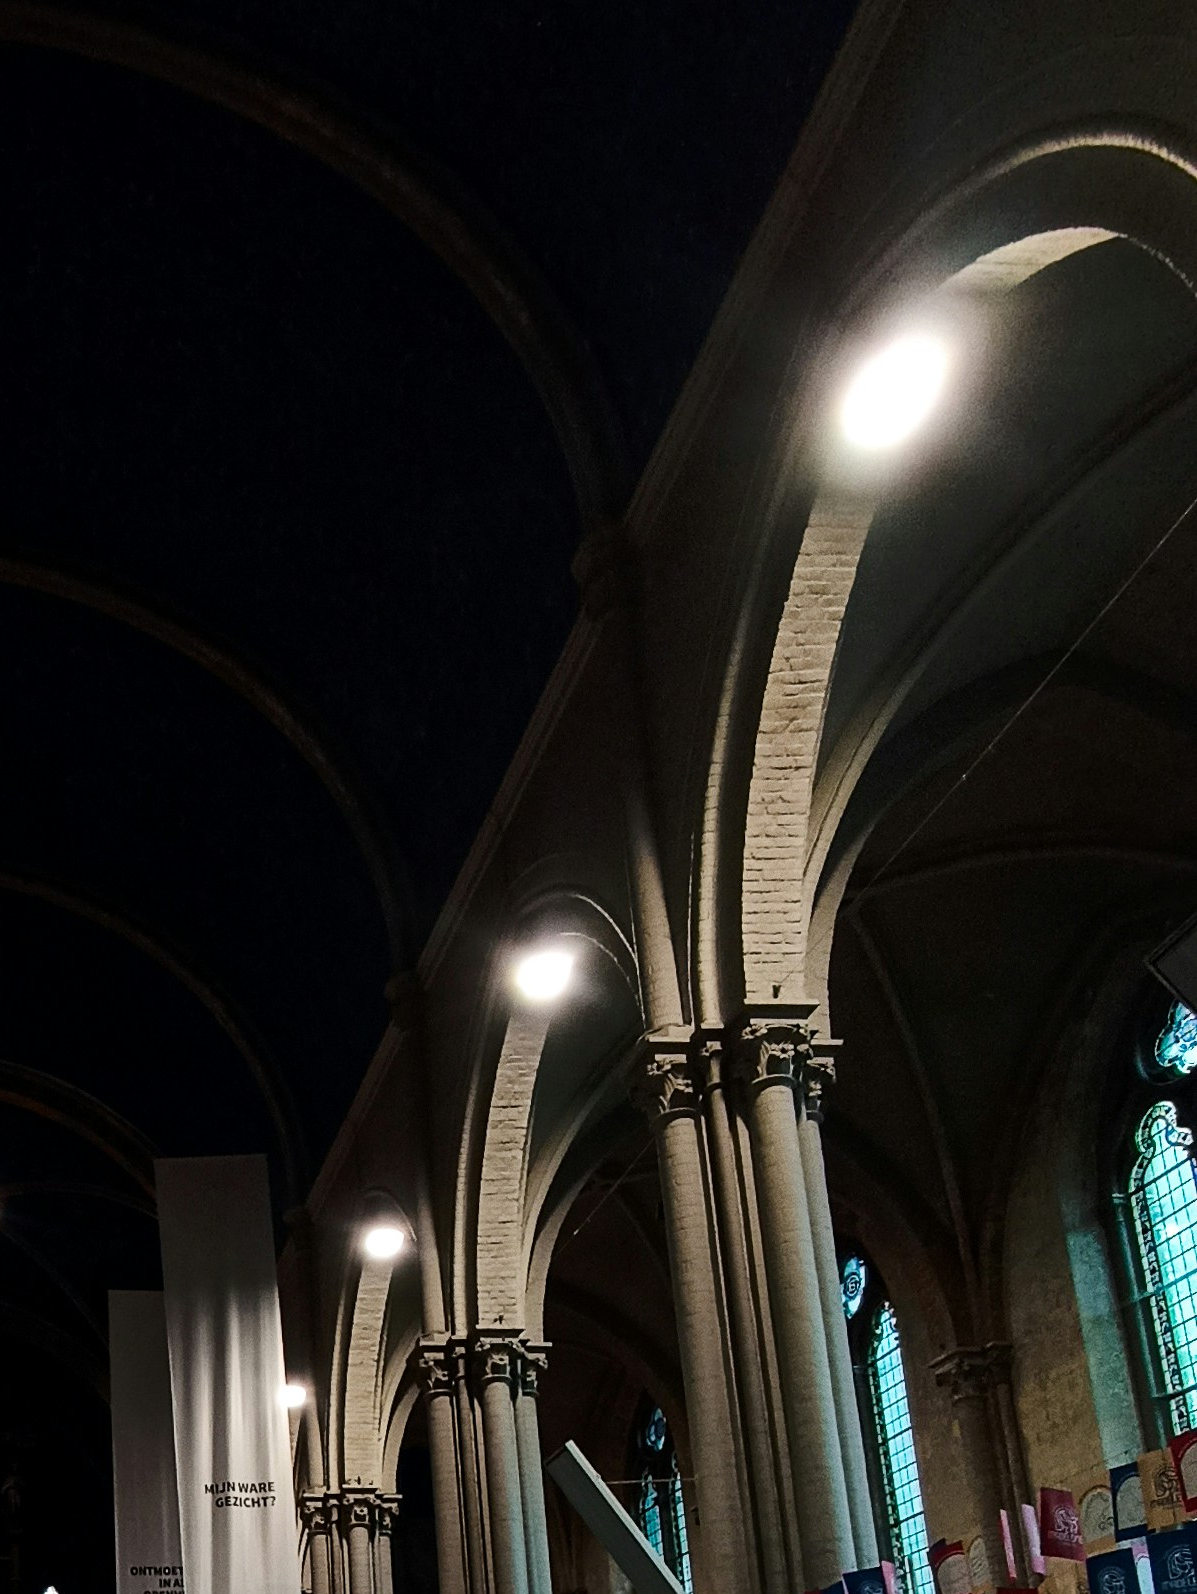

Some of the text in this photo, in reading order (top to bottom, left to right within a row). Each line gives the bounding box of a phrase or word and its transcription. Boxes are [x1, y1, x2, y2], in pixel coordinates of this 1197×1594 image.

[204, 1481, 274, 1494] MIJN WARE
[215, 1496, 275, 1507] GEZICHT?
[129, 1566, 183, 1575] ONTMOET
[158, 1578, 171, 1587] IN
